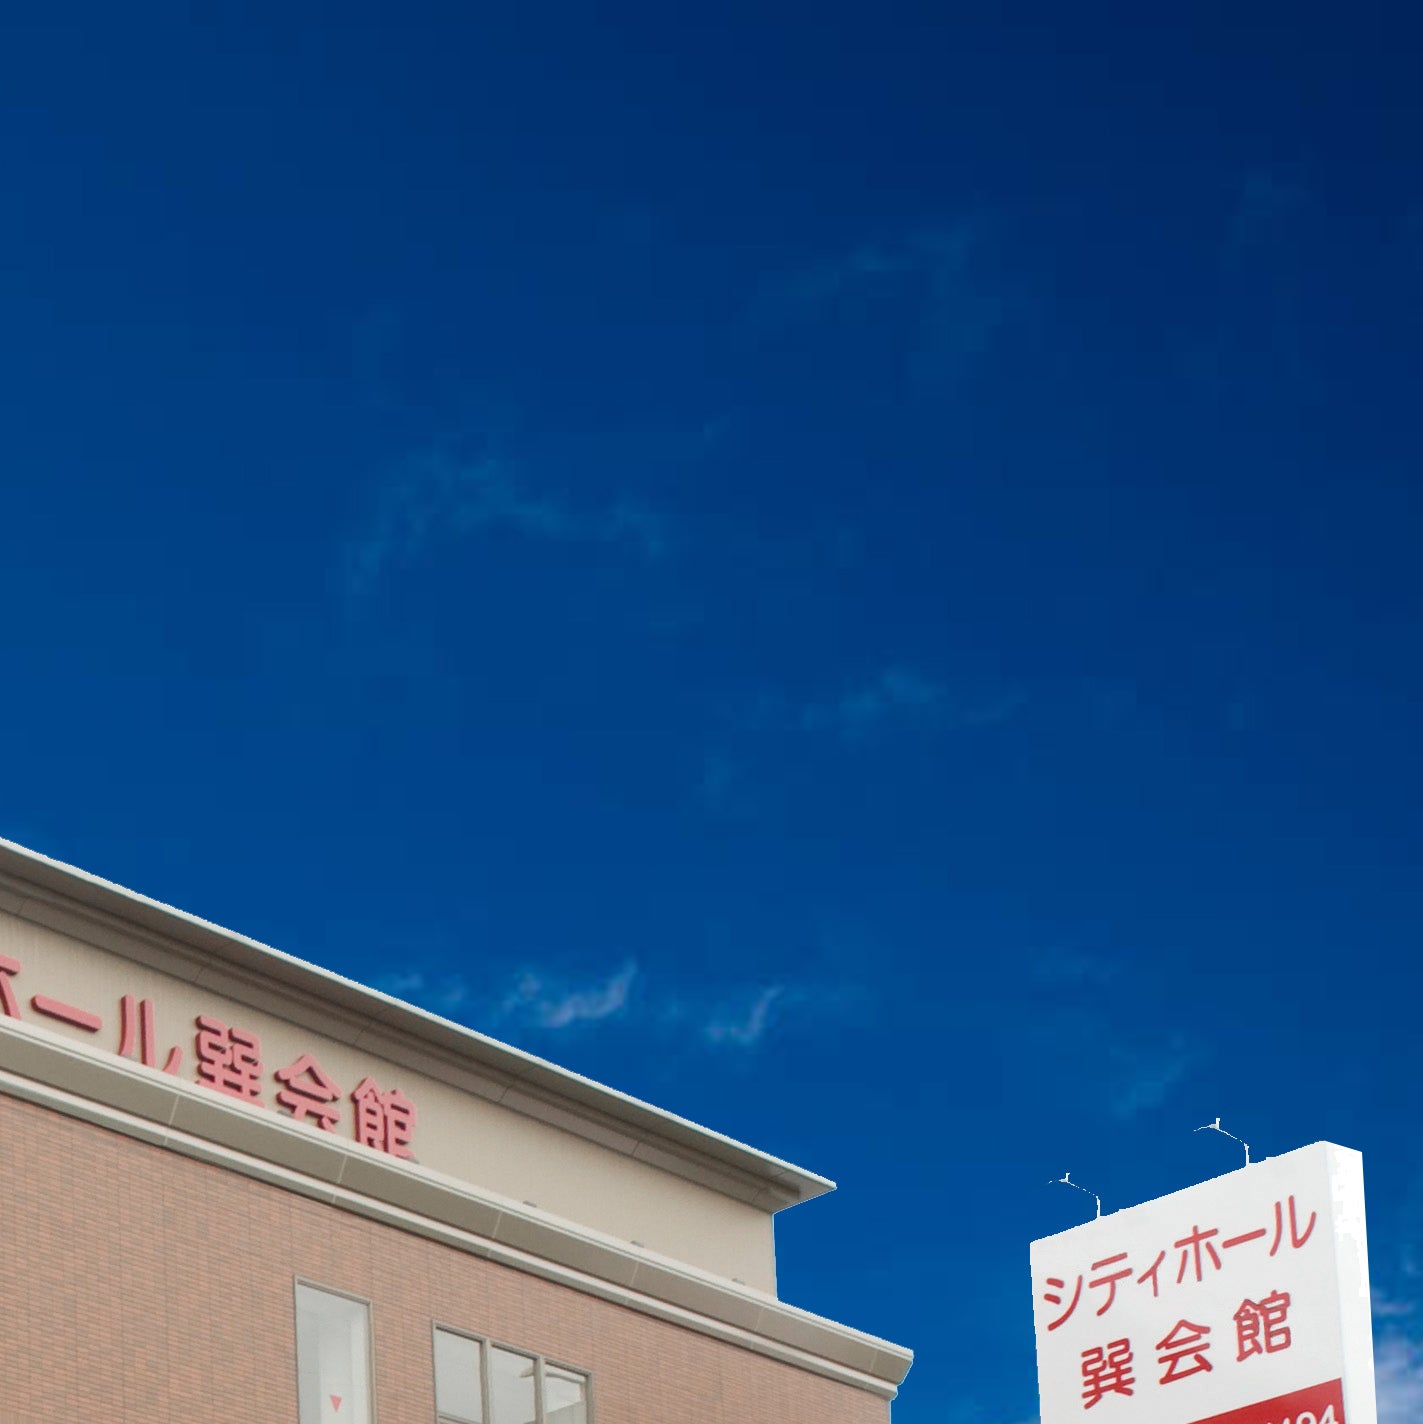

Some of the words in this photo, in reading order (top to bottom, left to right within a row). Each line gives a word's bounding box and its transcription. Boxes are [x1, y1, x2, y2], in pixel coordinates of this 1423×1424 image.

[1043, 1194, 1317, 1332] シティホール
[1080, 1289, 1292, 1410] 巽会館
